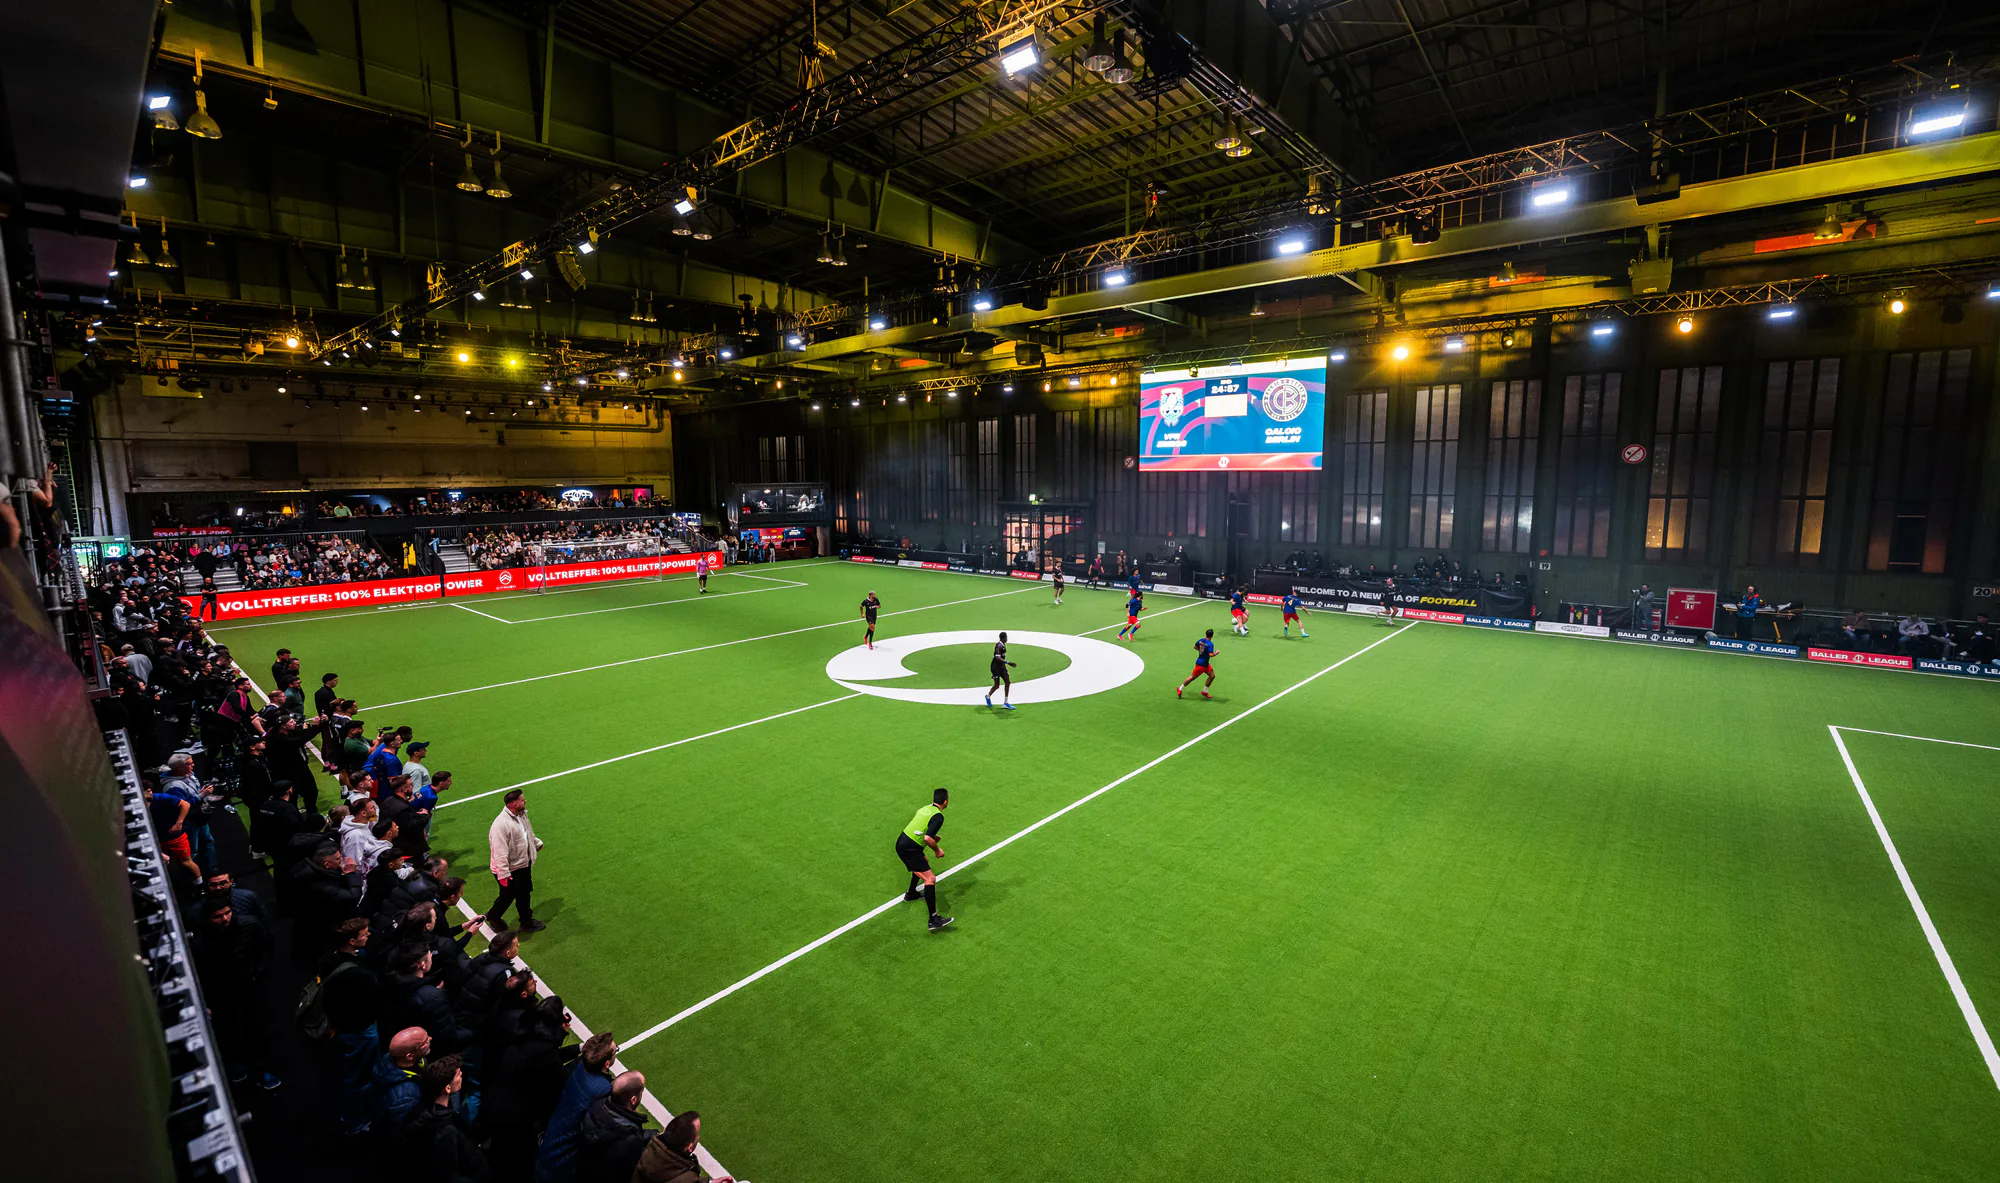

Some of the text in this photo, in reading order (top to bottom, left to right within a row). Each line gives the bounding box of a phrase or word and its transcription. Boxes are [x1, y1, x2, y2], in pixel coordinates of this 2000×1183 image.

[1211, 384, 1240, 394] 24:57
[528, 559, 697, 582] VOLLTREFFER: 100% ELEKTROPOWER
[219, 579, 483, 612] VOLLTREFFER: 100% ELEKTROPOWER
[1292, 586, 1336, 596] WELCOME
[1337, 589, 1350, 597] TO
[1351, 590, 1358, 598] A
[1360, 591, 1382, 600] NEW
[1405, 595, 1420, 603] OF
[1420, 596, 1477, 607] FOOTBALL
[1975, 588, 1992, 596] 20
[1662, 636, 1695, 644] LEAGUE
[1709, 640, 1797, 655] BALLER LEAGUE
[1811, 651, 1909, 666] BALLER LEAGUE
[1920, 661, 1962, 671] BALLER
